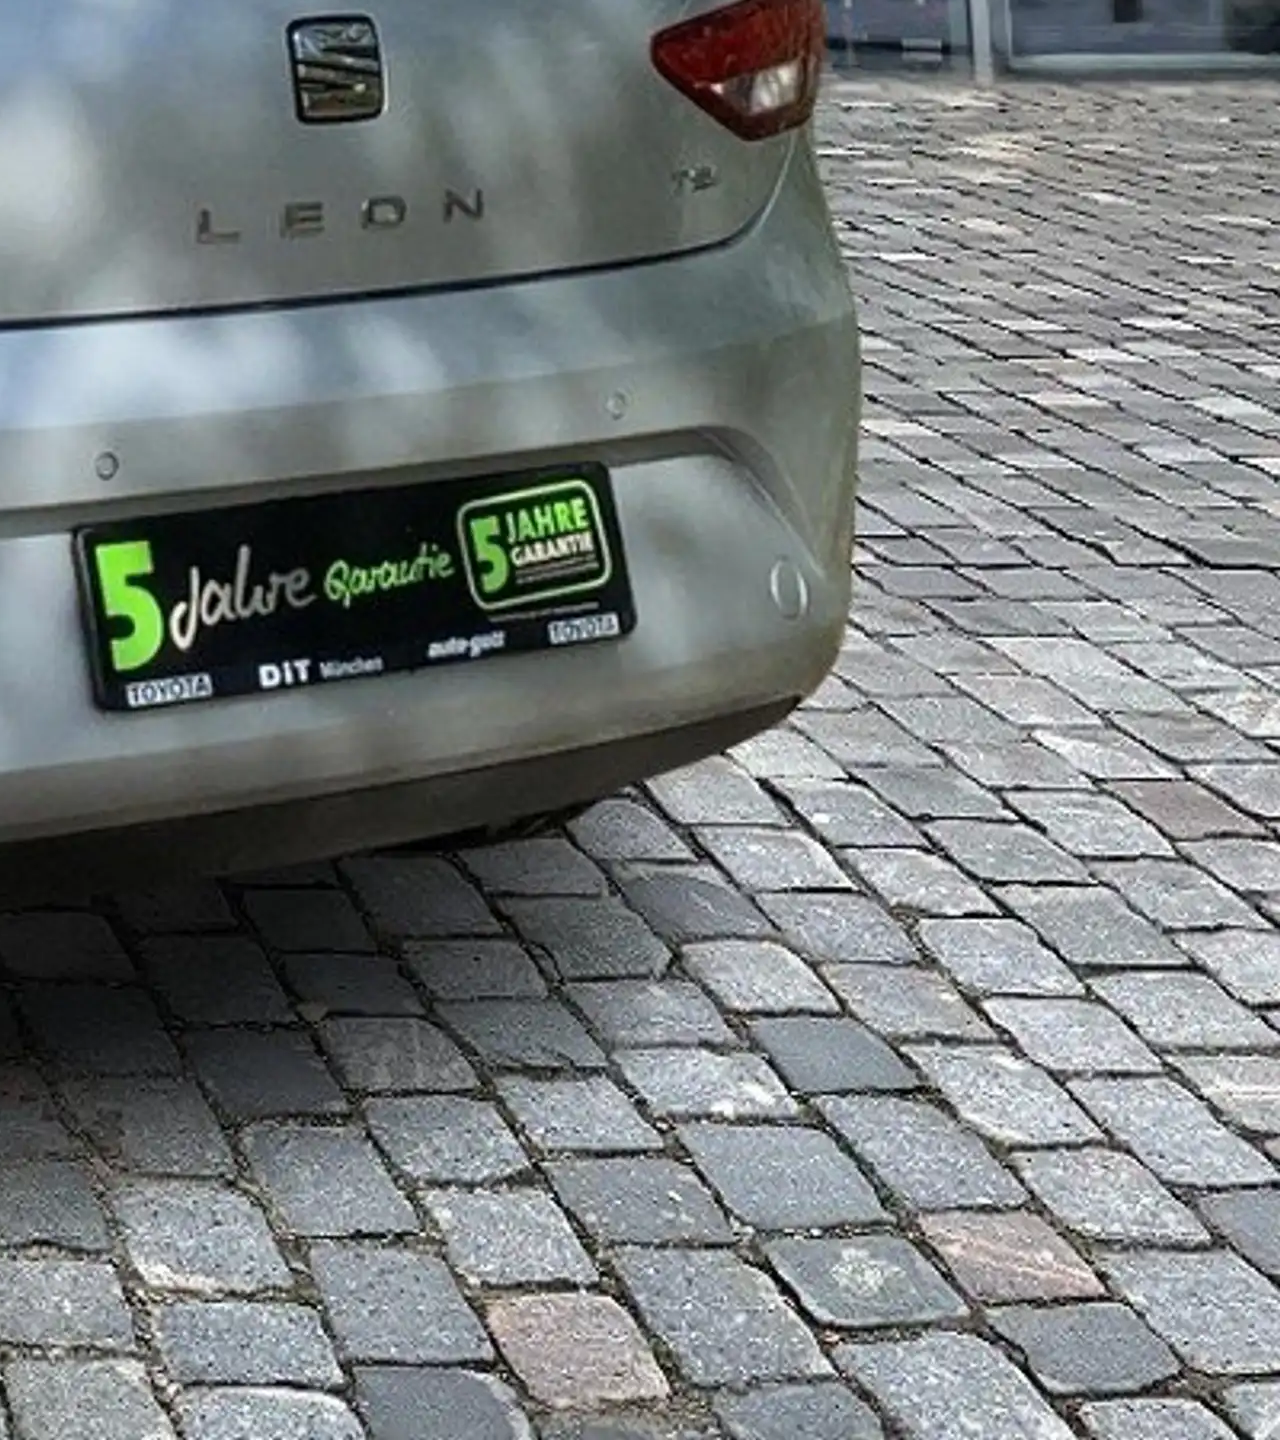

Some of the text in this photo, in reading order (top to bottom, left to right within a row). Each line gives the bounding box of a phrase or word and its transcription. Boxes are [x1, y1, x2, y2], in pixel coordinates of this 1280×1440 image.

[195, 187, 484, 245] LEON
[505, 497, 589, 545] JAHRE
[470, 515, 509, 593] 5
[511, 531, 594, 567] GARANTIE
[95, 540, 164, 672] 5
[169, 544, 317, 651] Jahre
[127, 674, 212, 707] TOYOTA
